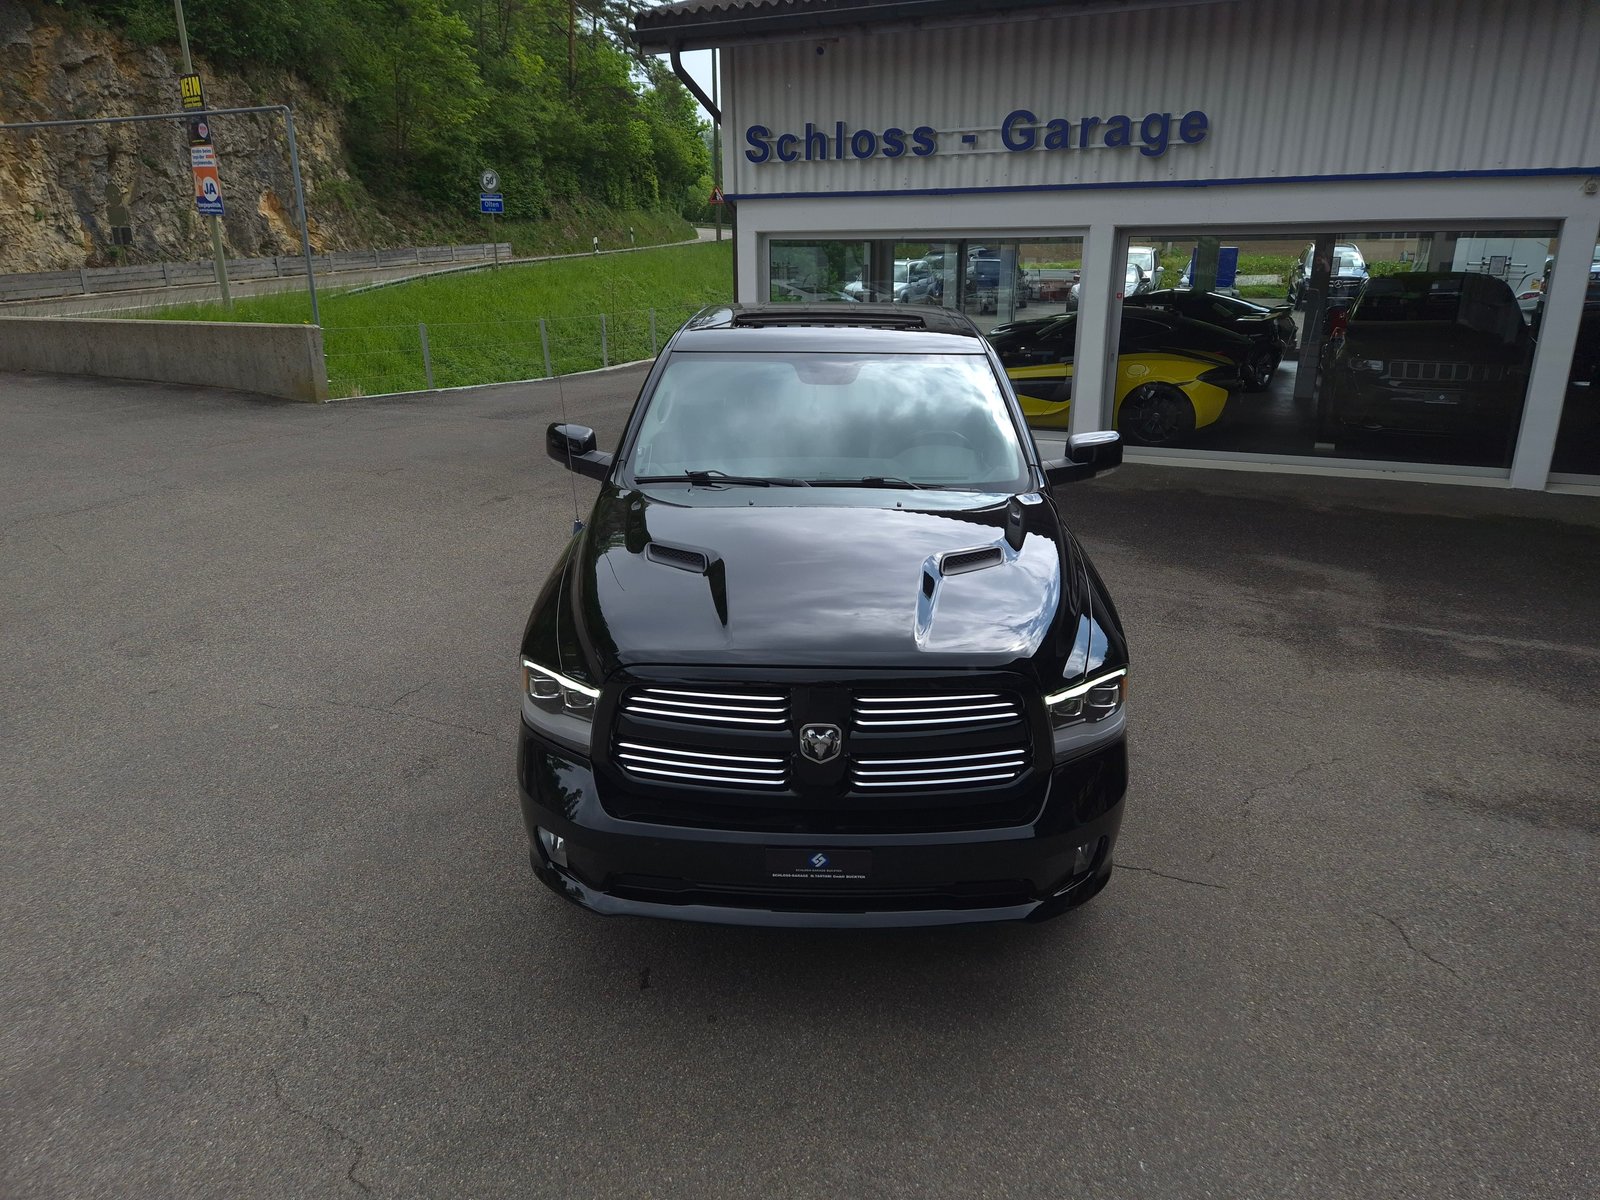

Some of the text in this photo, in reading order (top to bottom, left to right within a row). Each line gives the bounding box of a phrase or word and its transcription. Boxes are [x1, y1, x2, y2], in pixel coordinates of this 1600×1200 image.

[745, 121, 937, 164] Schloss
[1001, 109, 1209, 158] Garage
[204, 183, 217, 194] JA
